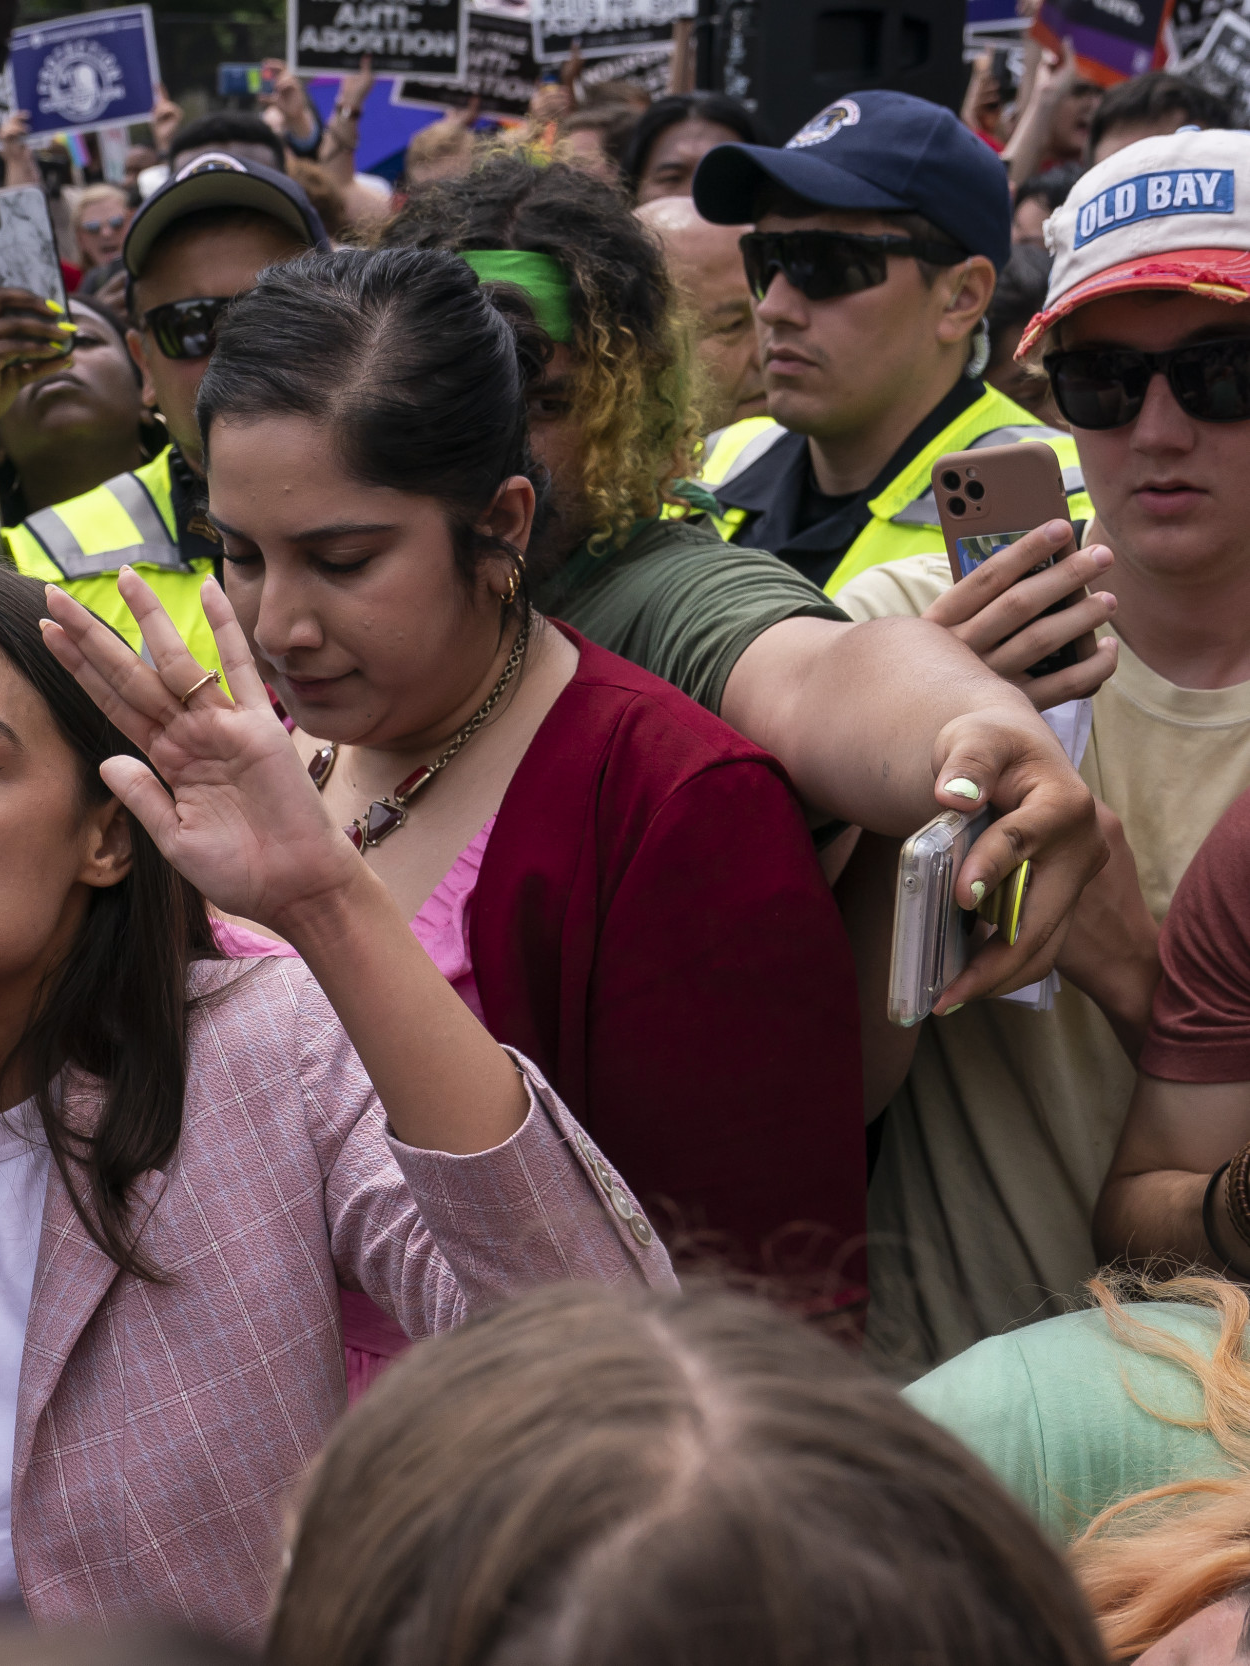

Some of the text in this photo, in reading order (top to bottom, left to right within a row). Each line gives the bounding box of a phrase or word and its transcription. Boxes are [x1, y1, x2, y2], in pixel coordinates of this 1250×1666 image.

[333, 2, 423, 30] ANTI-
[299, 25, 457, 57] ABORTION
[1080, 172, 1222, 238] OLD BAY
